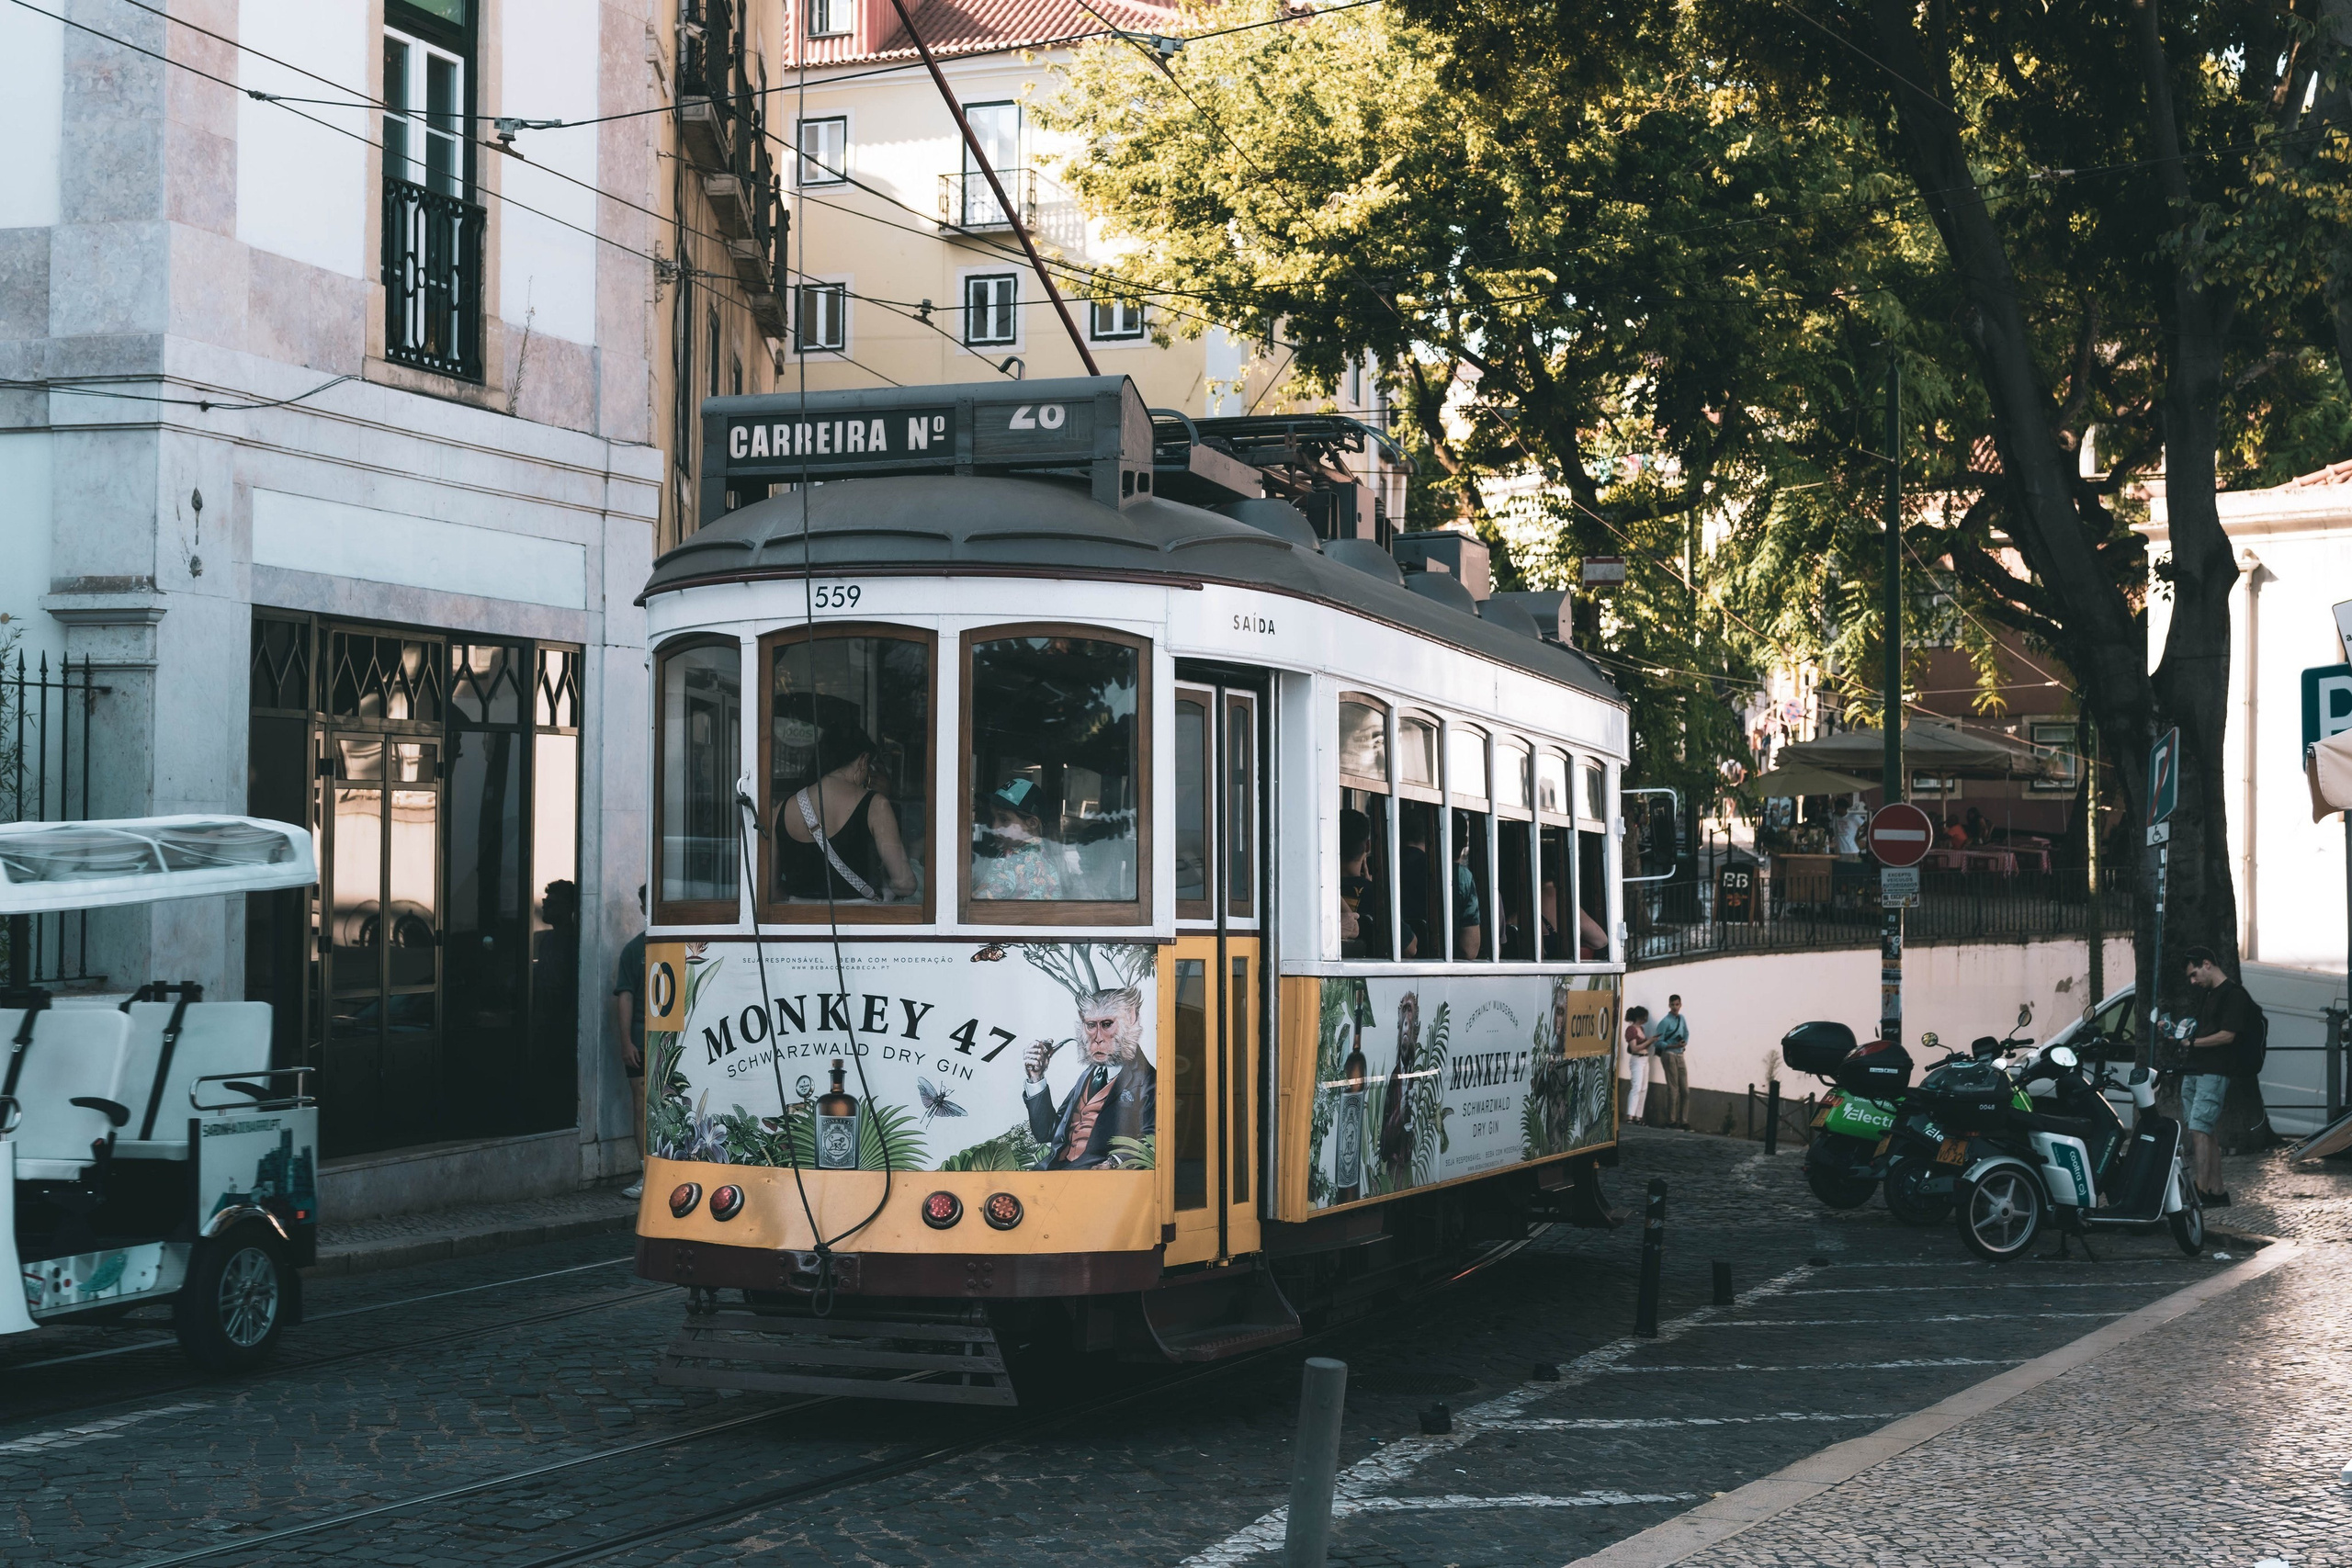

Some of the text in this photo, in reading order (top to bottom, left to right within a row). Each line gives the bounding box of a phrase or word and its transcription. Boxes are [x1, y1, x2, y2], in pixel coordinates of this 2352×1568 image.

[729, 418, 888, 459] CARREIRA
[814, 584, 862, 608] 559
[1233, 612, 1275, 636] SAÍDA
[764, 955, 825, 964] RESPONSÁVEL
[893, 955, 955, 964] MODERAÇÃO
[701, 993, 1017, 1066] MONKEY 47
[1571, 1004, 1595, 1038] carris
[727, 1043, 974, 1081] SCHWARZWALD DRY GIN
[1449, 1051, 1527, 1091] MONKEY 47
[1462, 1096, 1510, 1117] SCHWARZWALD
[1473, 1120, 1499, 1138] DRY GIN
[2069, 1150, 2083, 1182] cooltra
